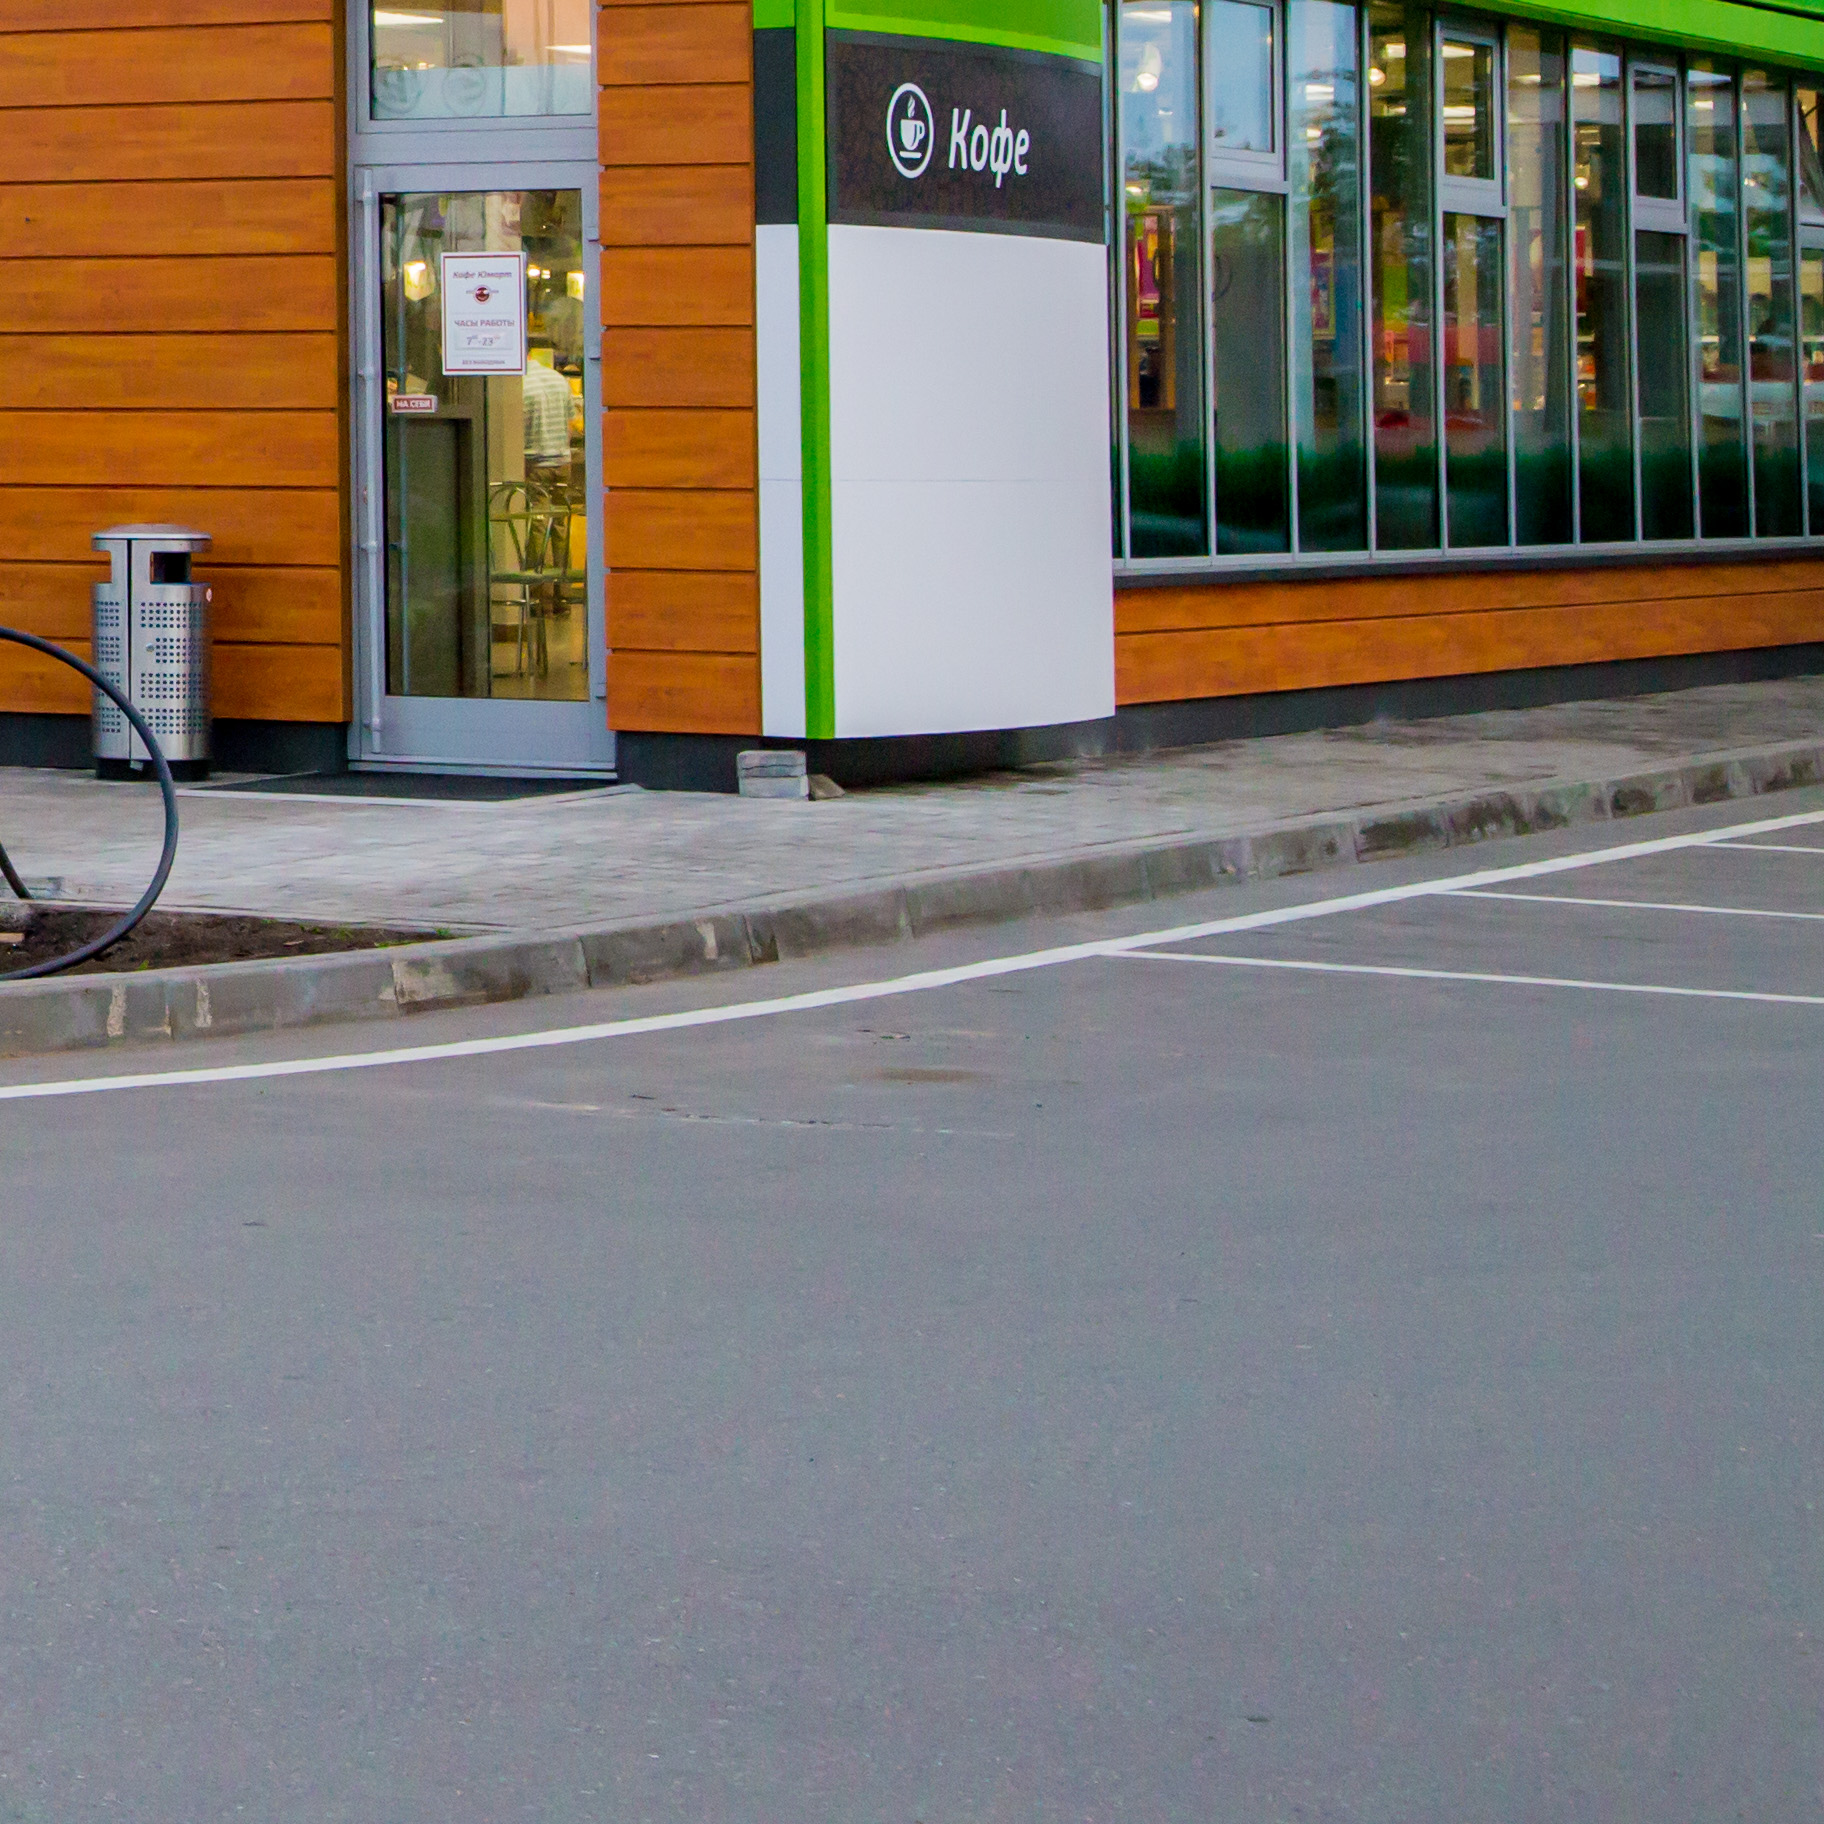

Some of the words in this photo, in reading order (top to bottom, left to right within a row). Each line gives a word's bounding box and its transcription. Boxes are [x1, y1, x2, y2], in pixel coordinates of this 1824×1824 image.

[948, 107, 1031, 189] Кофе
[454, 319, 478, 327] ЧАСЫ
[480, 319, 515, 327] РАБОТЫ
[396, 399, 410, 408] НА
